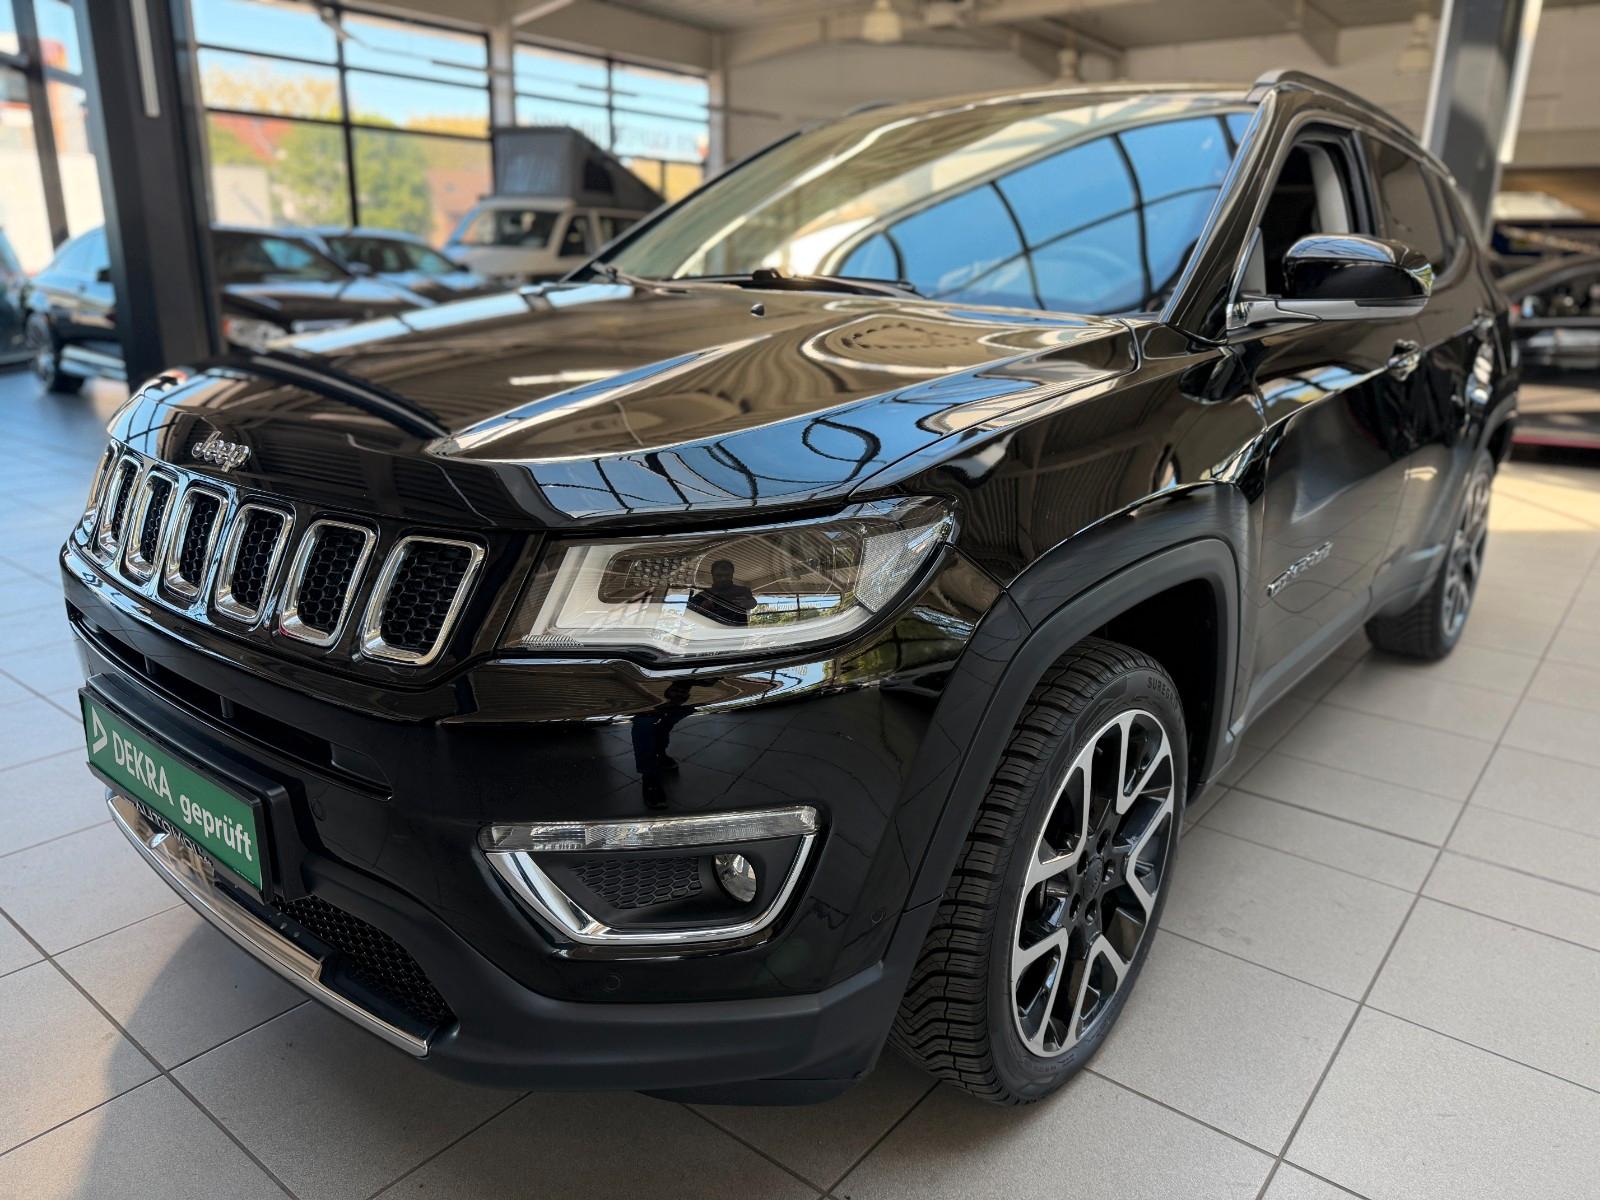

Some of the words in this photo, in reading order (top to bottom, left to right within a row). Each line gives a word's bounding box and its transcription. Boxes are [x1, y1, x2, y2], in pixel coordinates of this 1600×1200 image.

[191, 430, 251, 473] Jeep
[112, 730, 174, 806] DEKRA
[179, 793, 252, 861] geprüft
